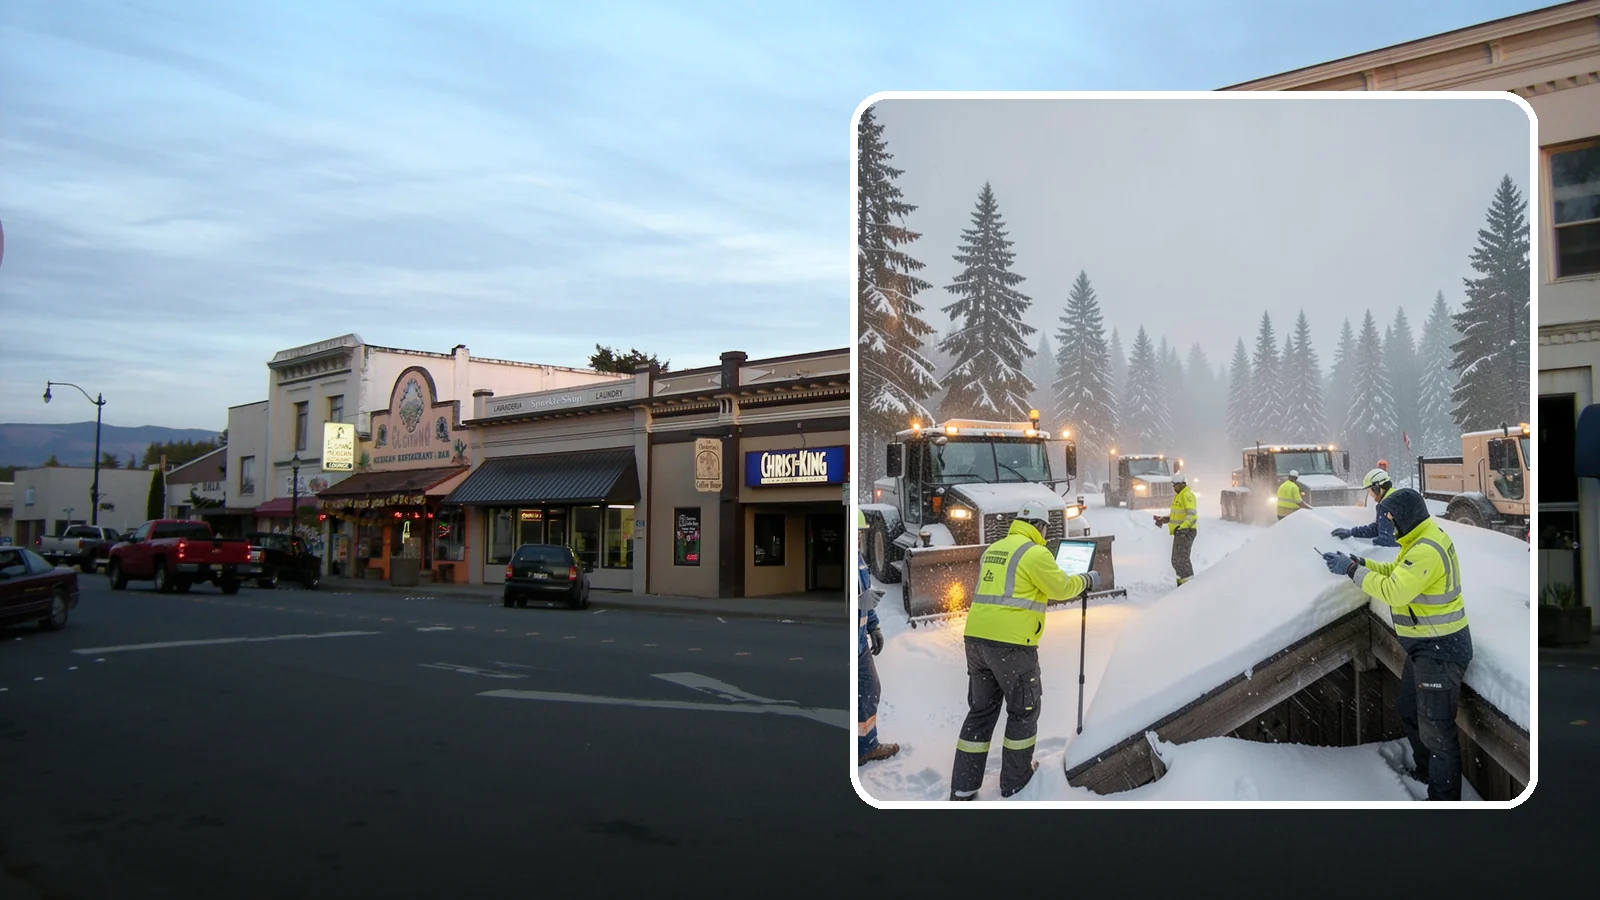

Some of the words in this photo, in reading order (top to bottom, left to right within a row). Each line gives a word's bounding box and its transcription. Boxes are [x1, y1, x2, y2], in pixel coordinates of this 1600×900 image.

[562, 393, 582, 405] Shop
[595, 388, 623, 400] LAUNDRY
[493, 402, 522, 413] LAVANDERIA
[374, 455, 396, 464] MEXICAN
[397, 451, 434, 462] RESTAURANT
[438, 450, 450, 459] BAR
[760, 451, 797, 478] CHRIST
[798, 449, 828, 476] KING
